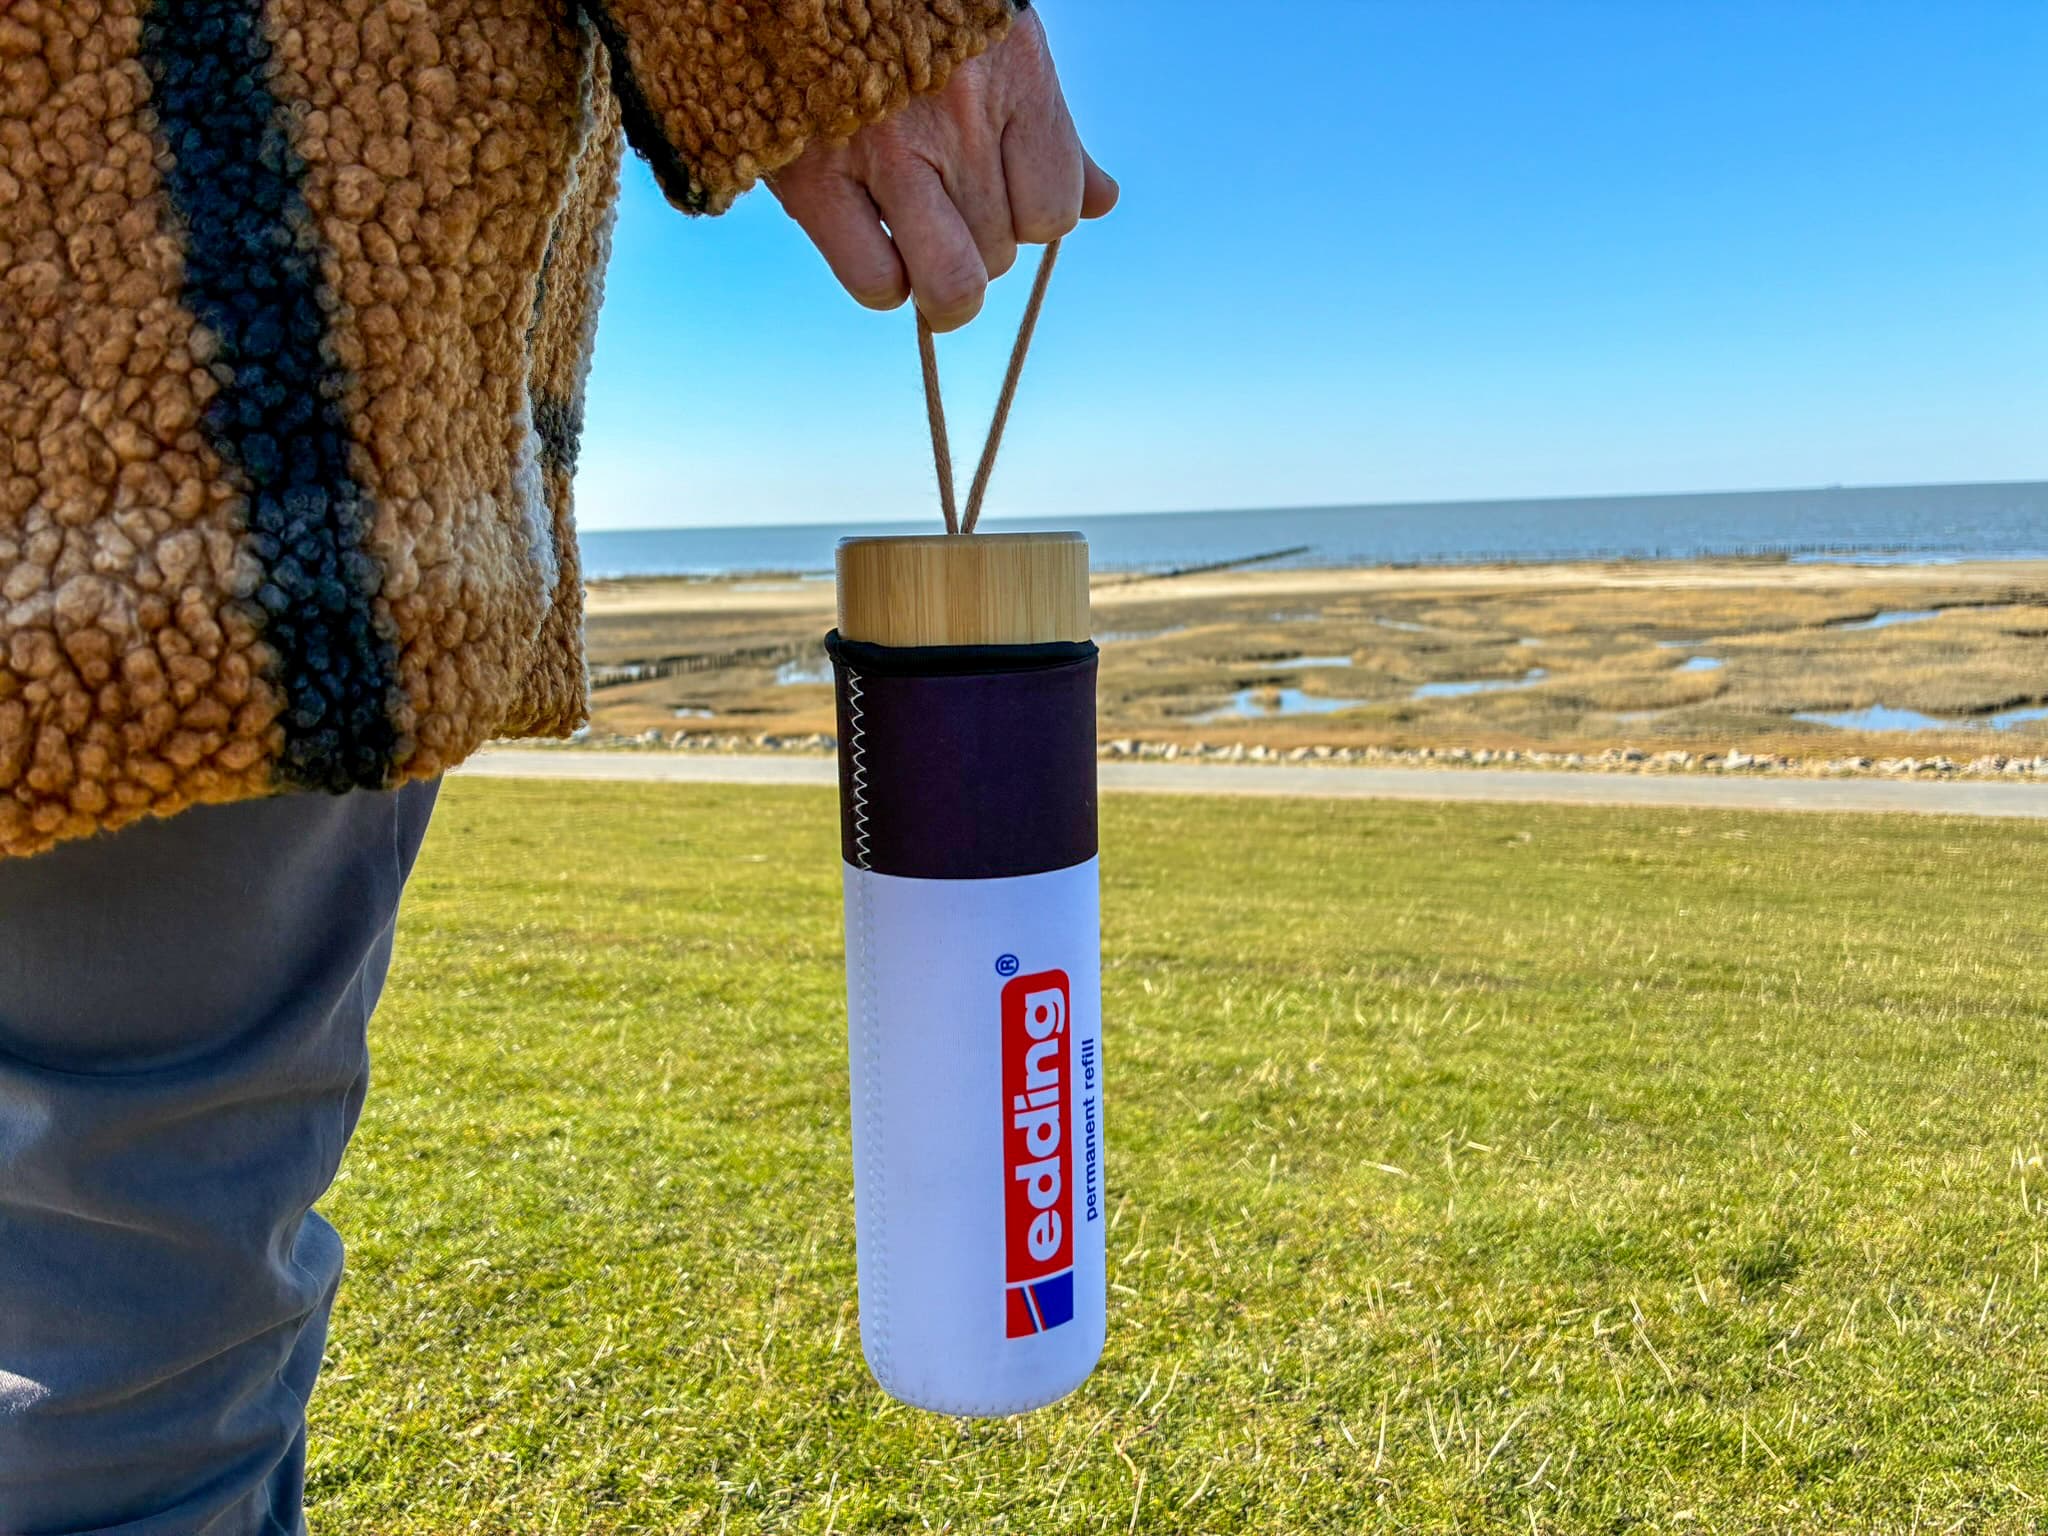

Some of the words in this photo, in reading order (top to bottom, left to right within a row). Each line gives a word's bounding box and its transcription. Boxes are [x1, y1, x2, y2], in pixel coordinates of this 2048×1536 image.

[1014, 987, 1065, 1262] edding
[1082, 1038, 1094, 1090] refill
[1083, 1095, 1098, 1222] permanent
